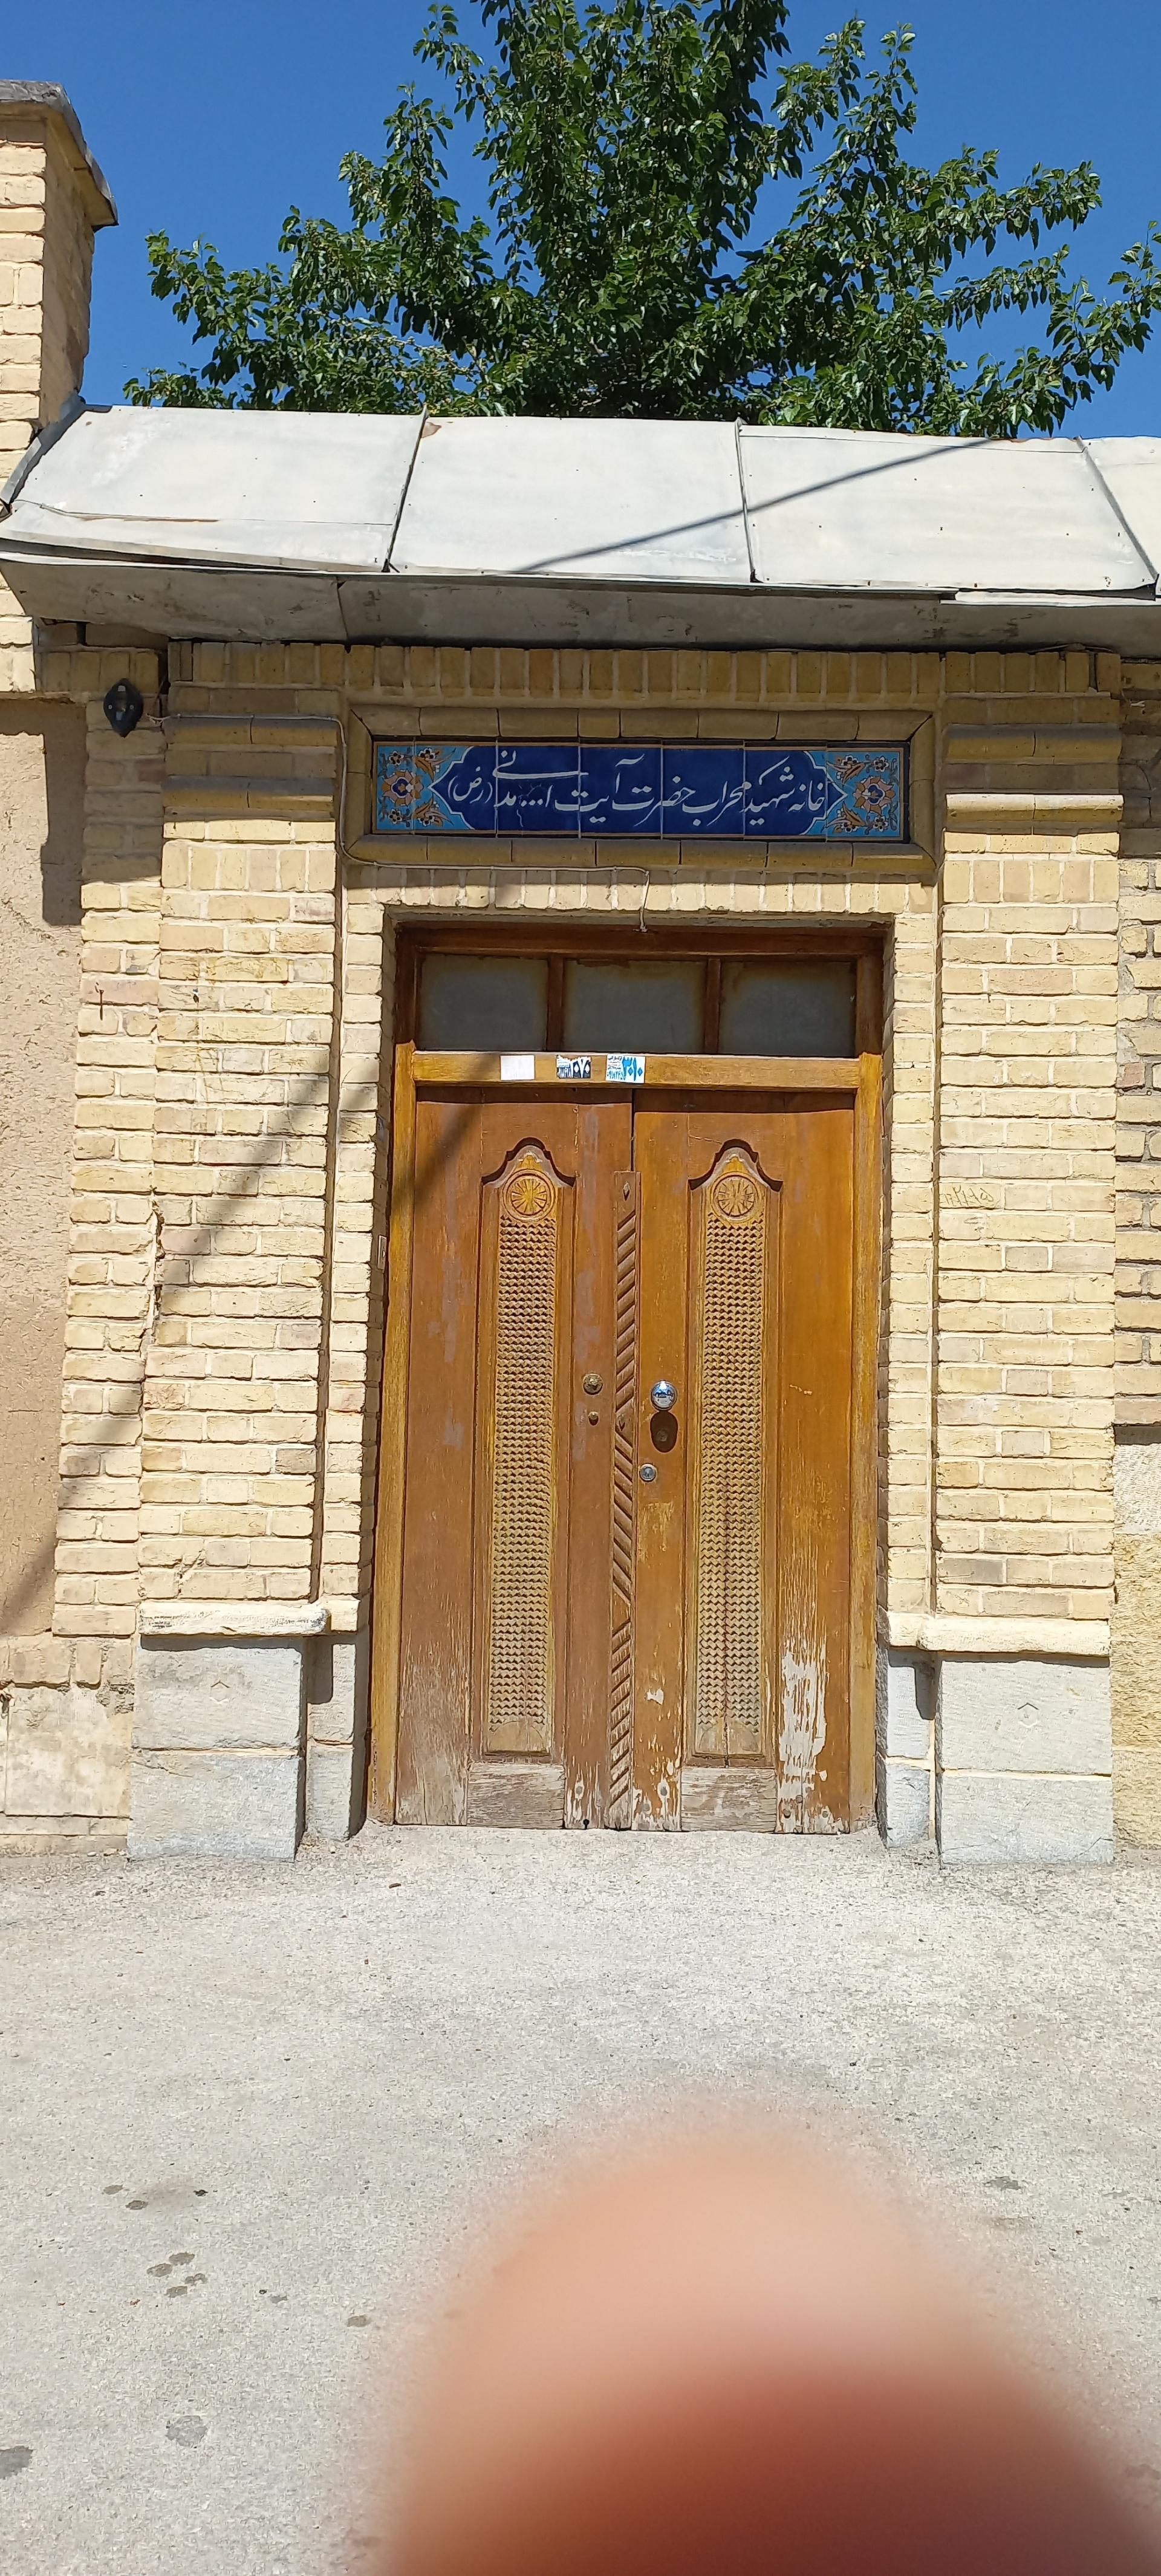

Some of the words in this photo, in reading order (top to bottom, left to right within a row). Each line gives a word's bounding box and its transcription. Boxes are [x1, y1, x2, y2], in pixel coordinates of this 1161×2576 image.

[448, 766, 493, 804] (رض)
[492, 749, 590, 808] مدنی
[554, 753, 645, 824] آیت
[611, 775, 697, 827] حضرت
[682, 780, 752, 827] محراب
[741, 755, 796, 826] شهید
[787, 780, 825, 812] خانه
